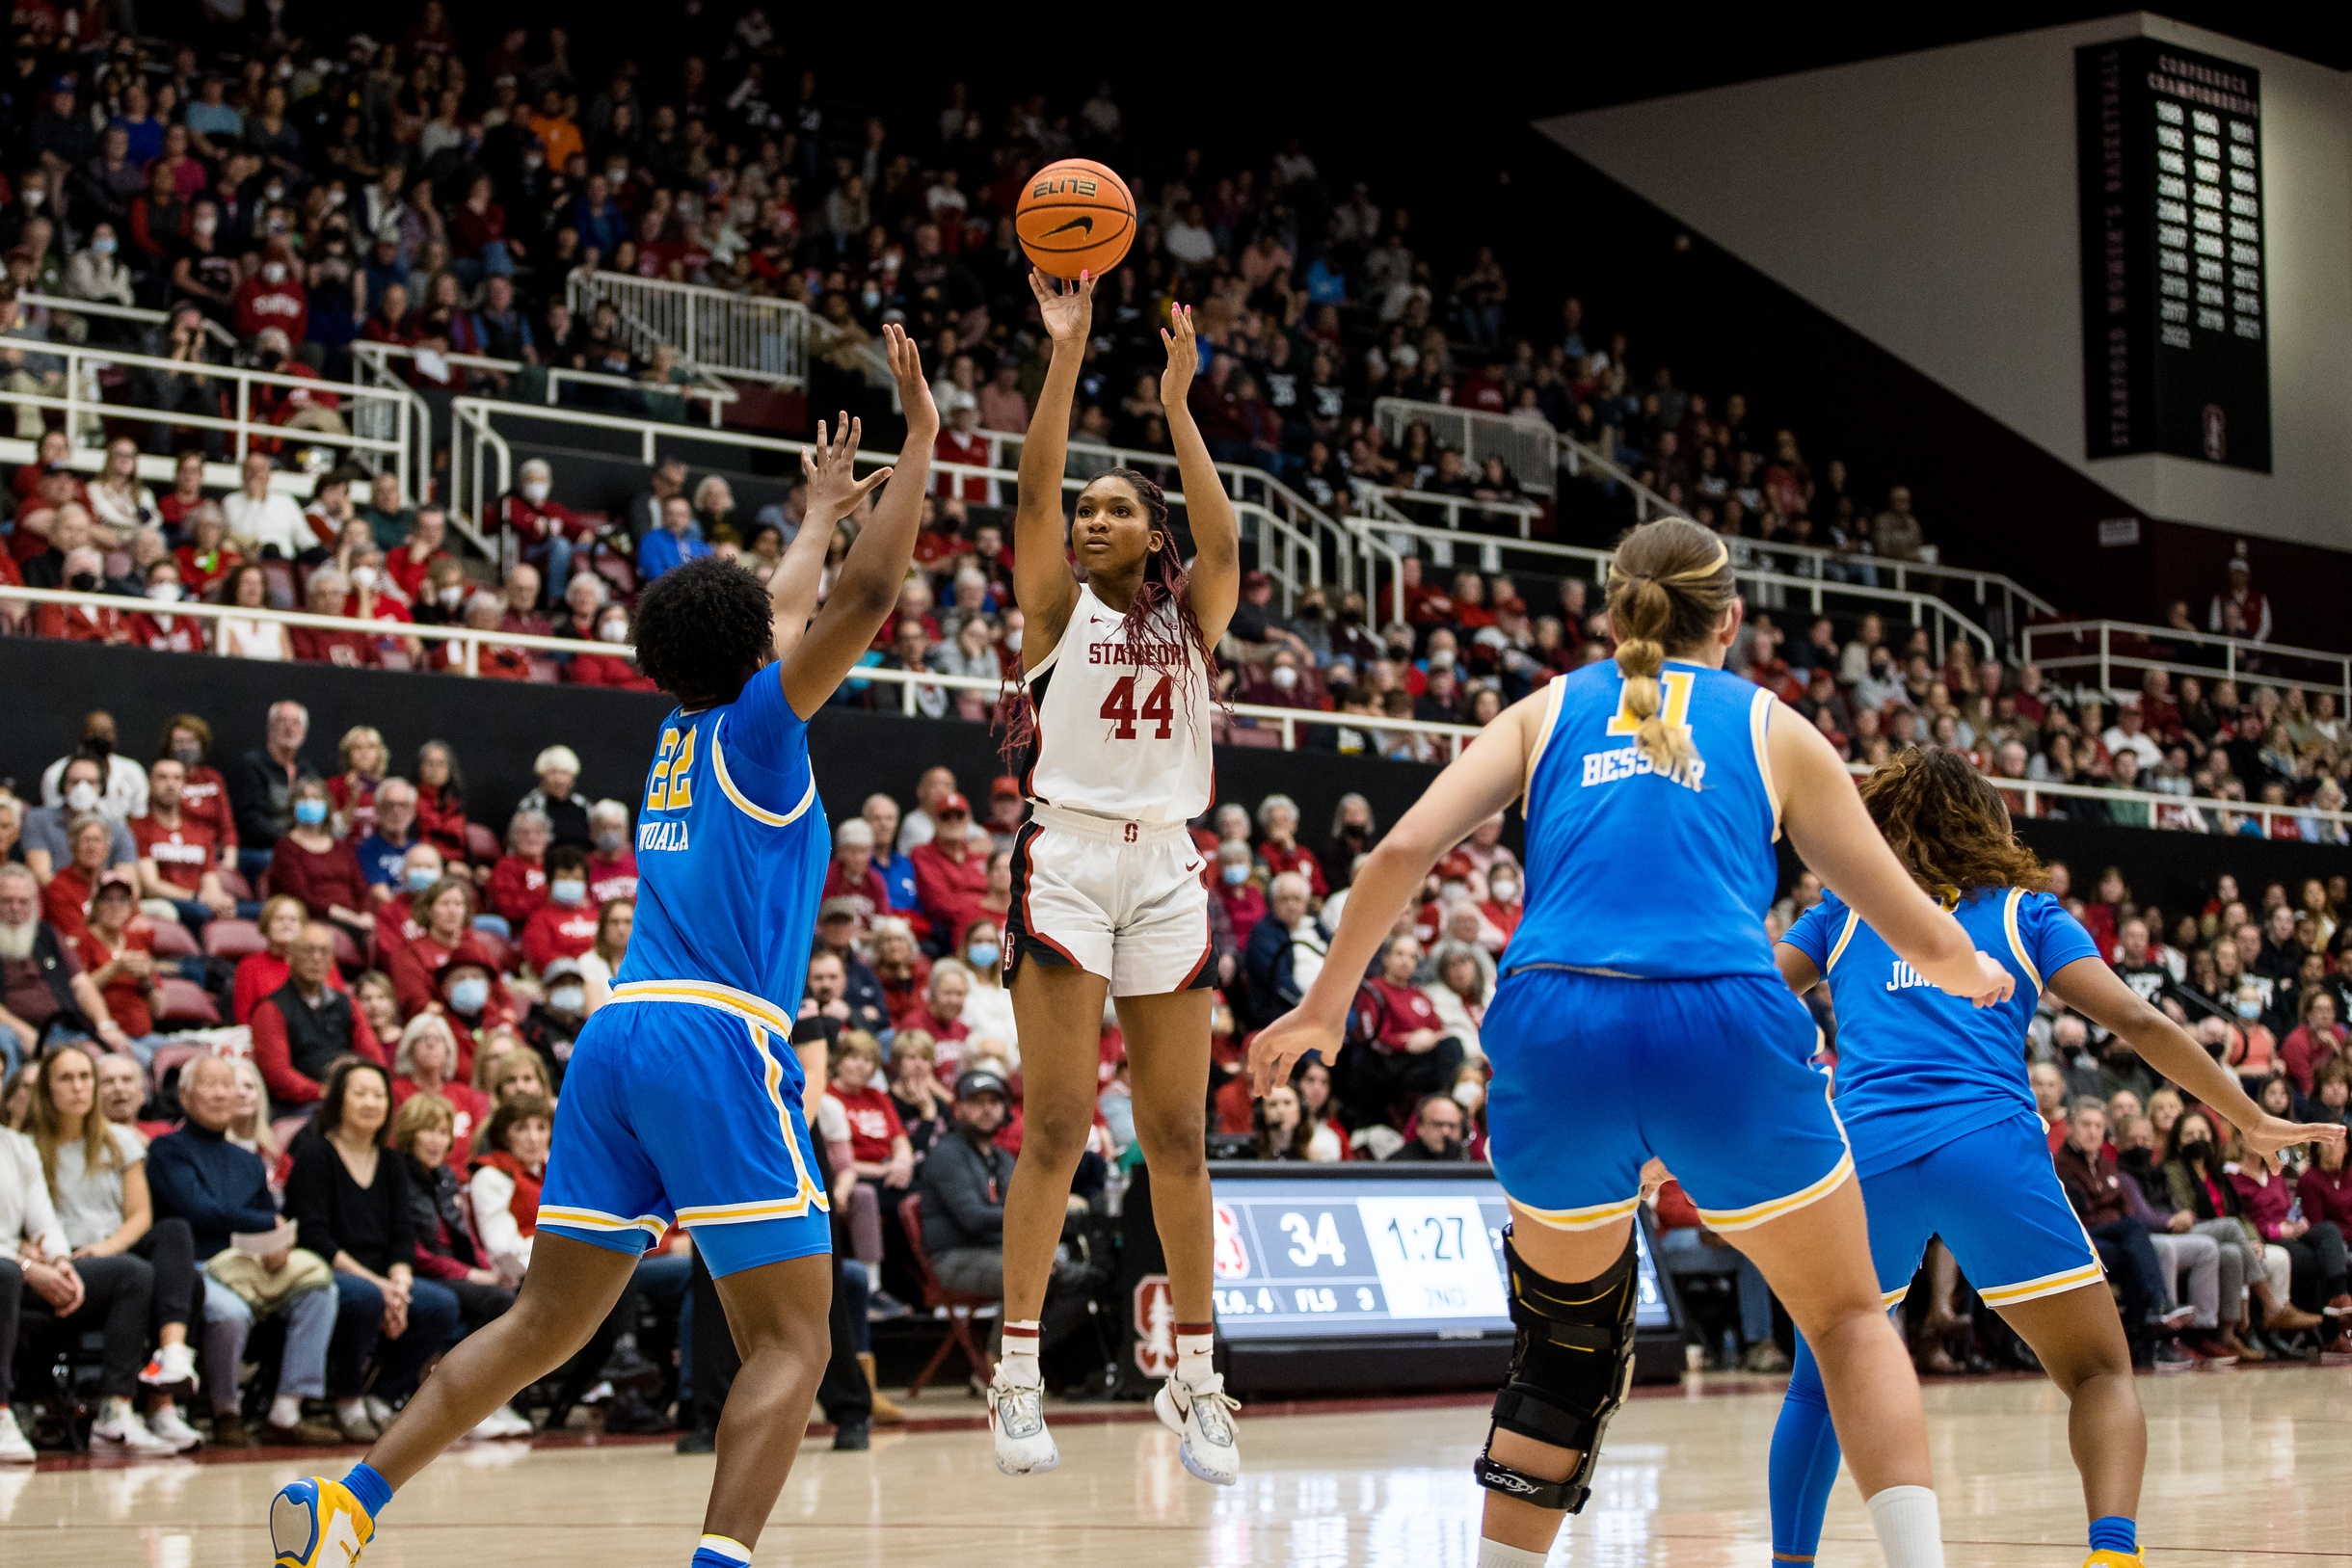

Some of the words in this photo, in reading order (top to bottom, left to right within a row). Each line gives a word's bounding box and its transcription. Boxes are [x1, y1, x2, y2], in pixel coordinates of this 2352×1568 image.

[1032, 178, 1097, 199] ELITE
[1088, 643, 1190, 665] STANFOR
[1099, 676, 1174, 739] 44
[646, 723, 699, 811] 22
[1279, 1211, 1347, 1266] 34
[1388, 1217, 1465, 1261] 1:27
[1256, 1287, 1274, 1314] 4
[1355, 1287, 1376, 1311] 3
[1484, 1471, 1539, 1494] DONJOY
